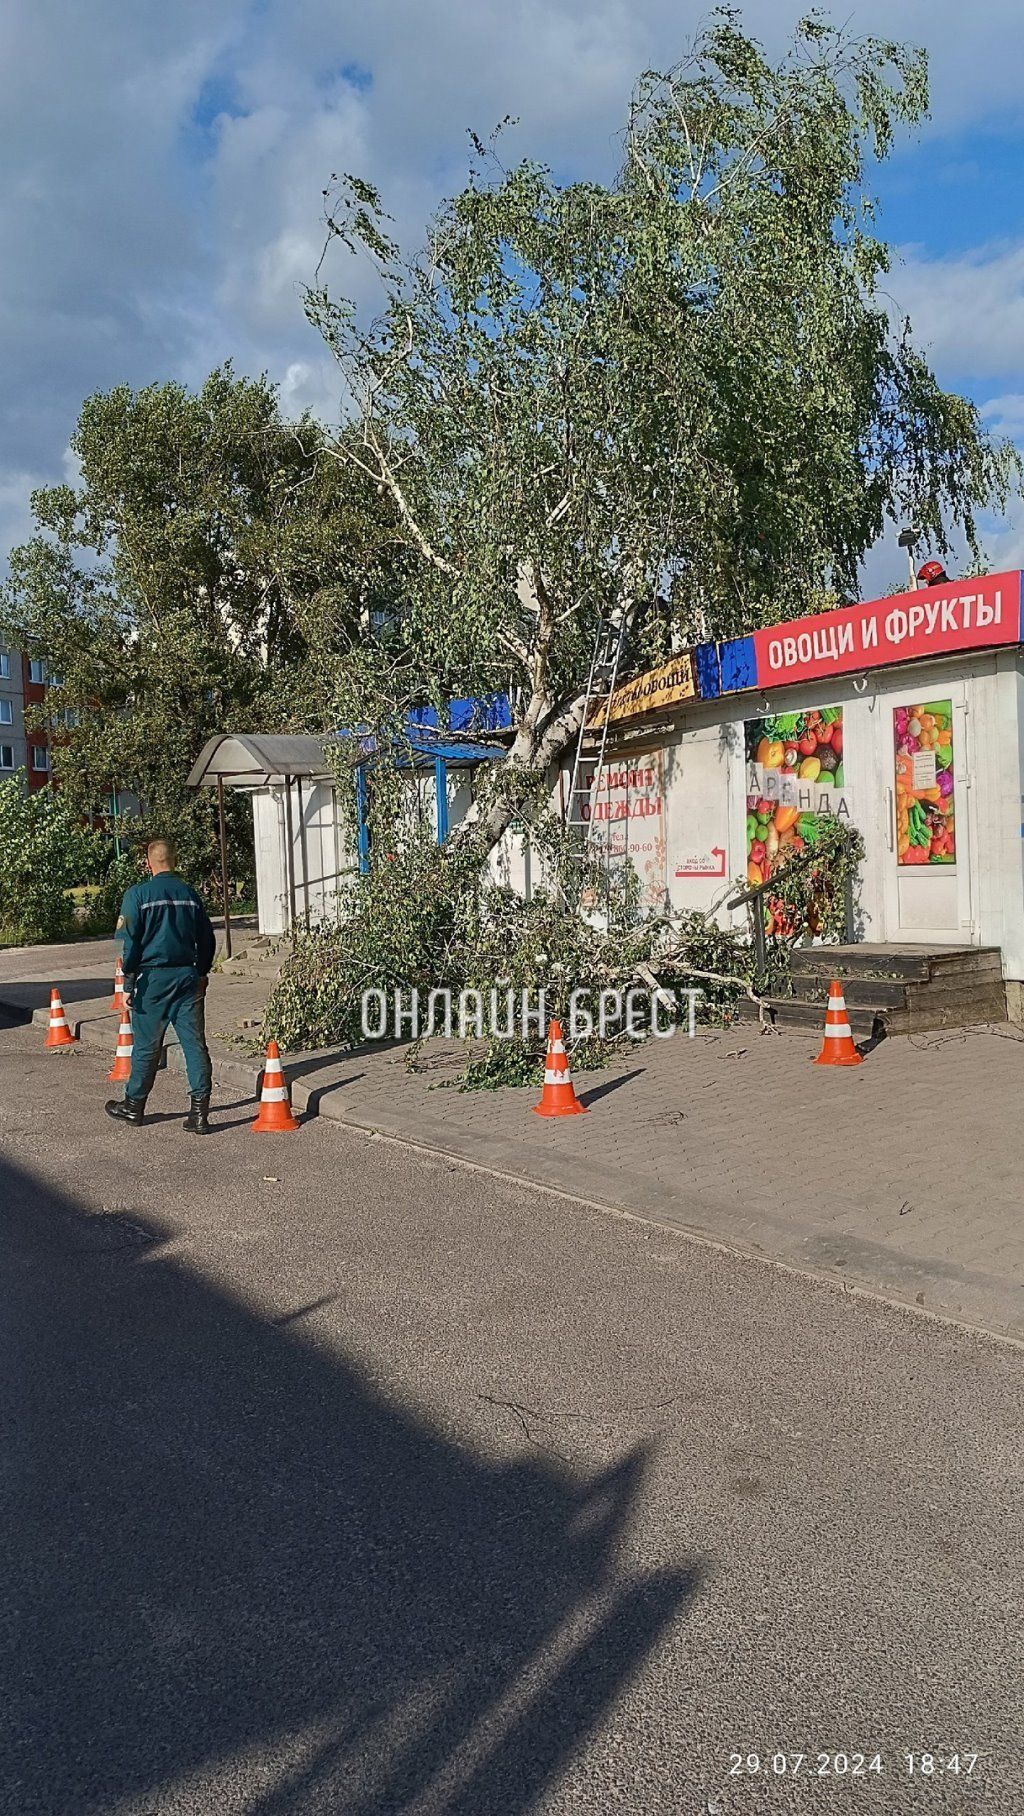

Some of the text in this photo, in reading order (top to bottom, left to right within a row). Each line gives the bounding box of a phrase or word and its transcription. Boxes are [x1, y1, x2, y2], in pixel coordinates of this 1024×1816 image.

[769, 590, 1001, 669] ОВОЩИ И ФРУКТЫ
[586, 768, 654, 792] РЕМОНТ
[750, 773, 850, 818] АРЕНДА
[581, 796, 662, 821] ОДЕЖДЫ
